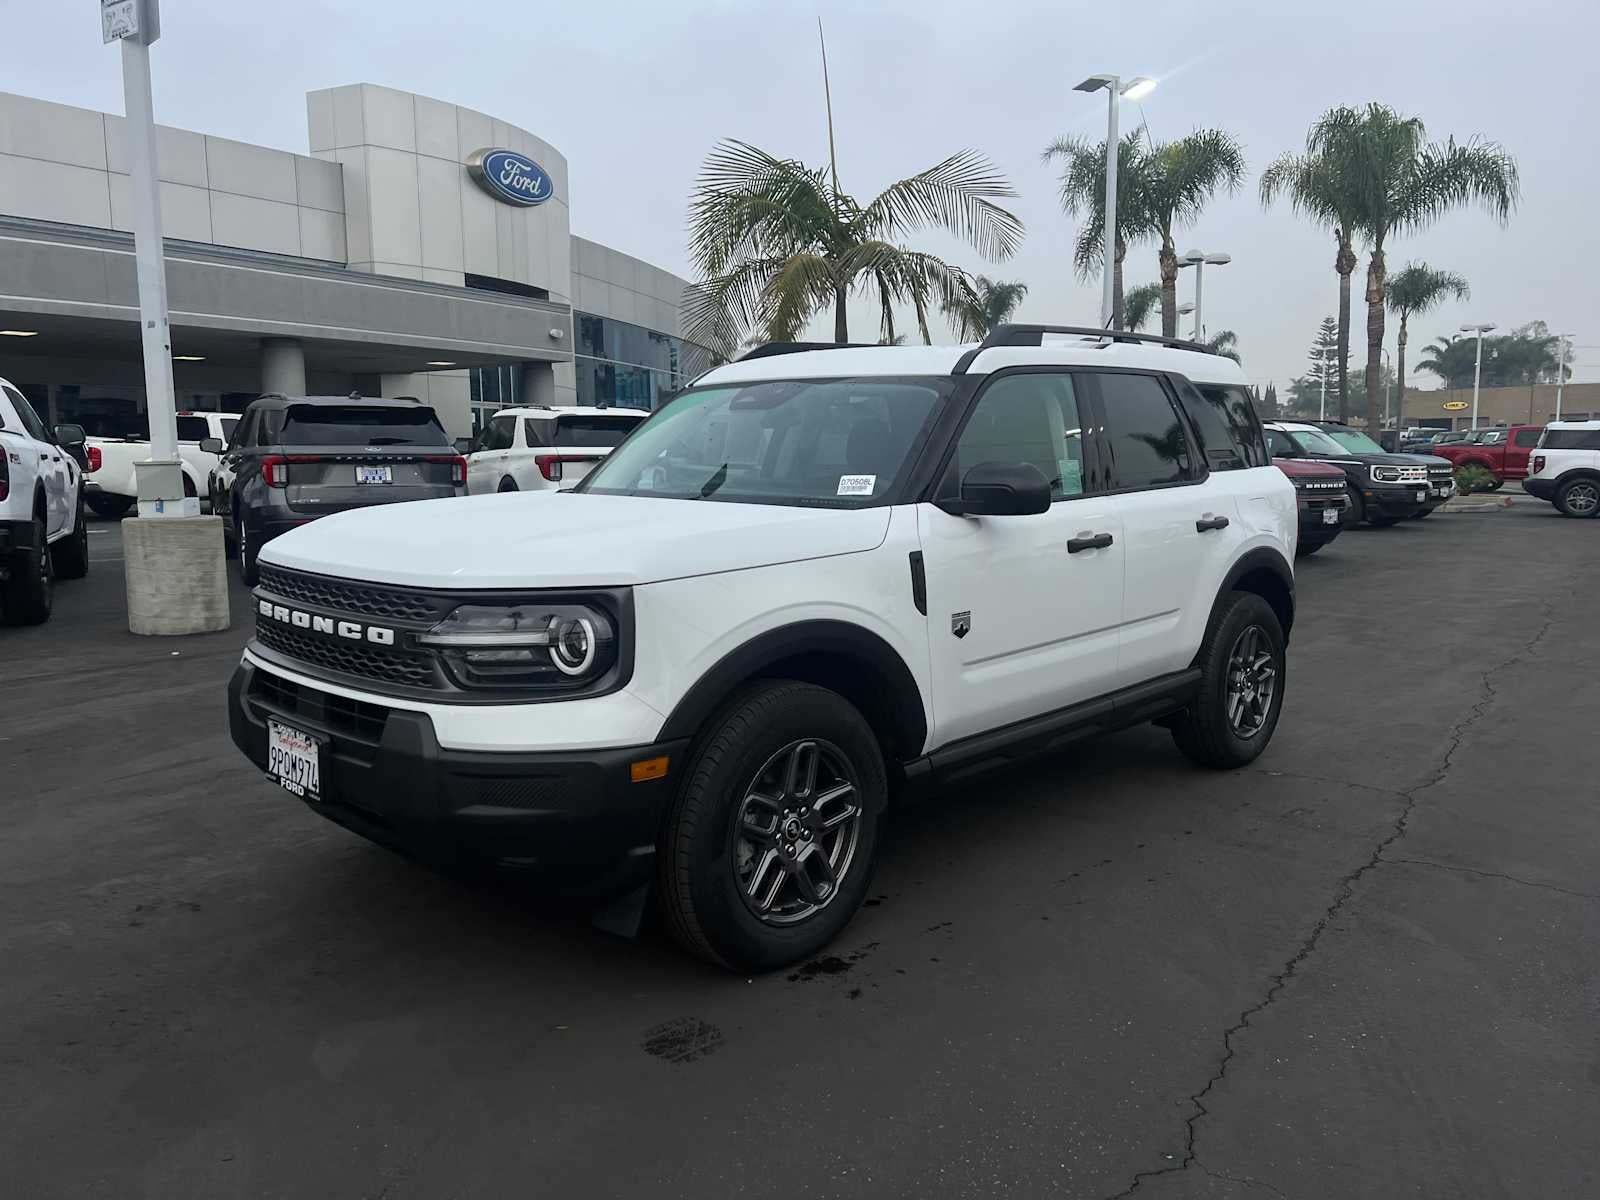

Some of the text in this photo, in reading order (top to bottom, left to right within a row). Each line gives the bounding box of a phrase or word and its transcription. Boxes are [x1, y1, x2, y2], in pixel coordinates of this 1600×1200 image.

[500, 158, 541, 195] Ford
[259, 600, 394, 645] BRONCO
[279, 777, 305, 796] FORD
